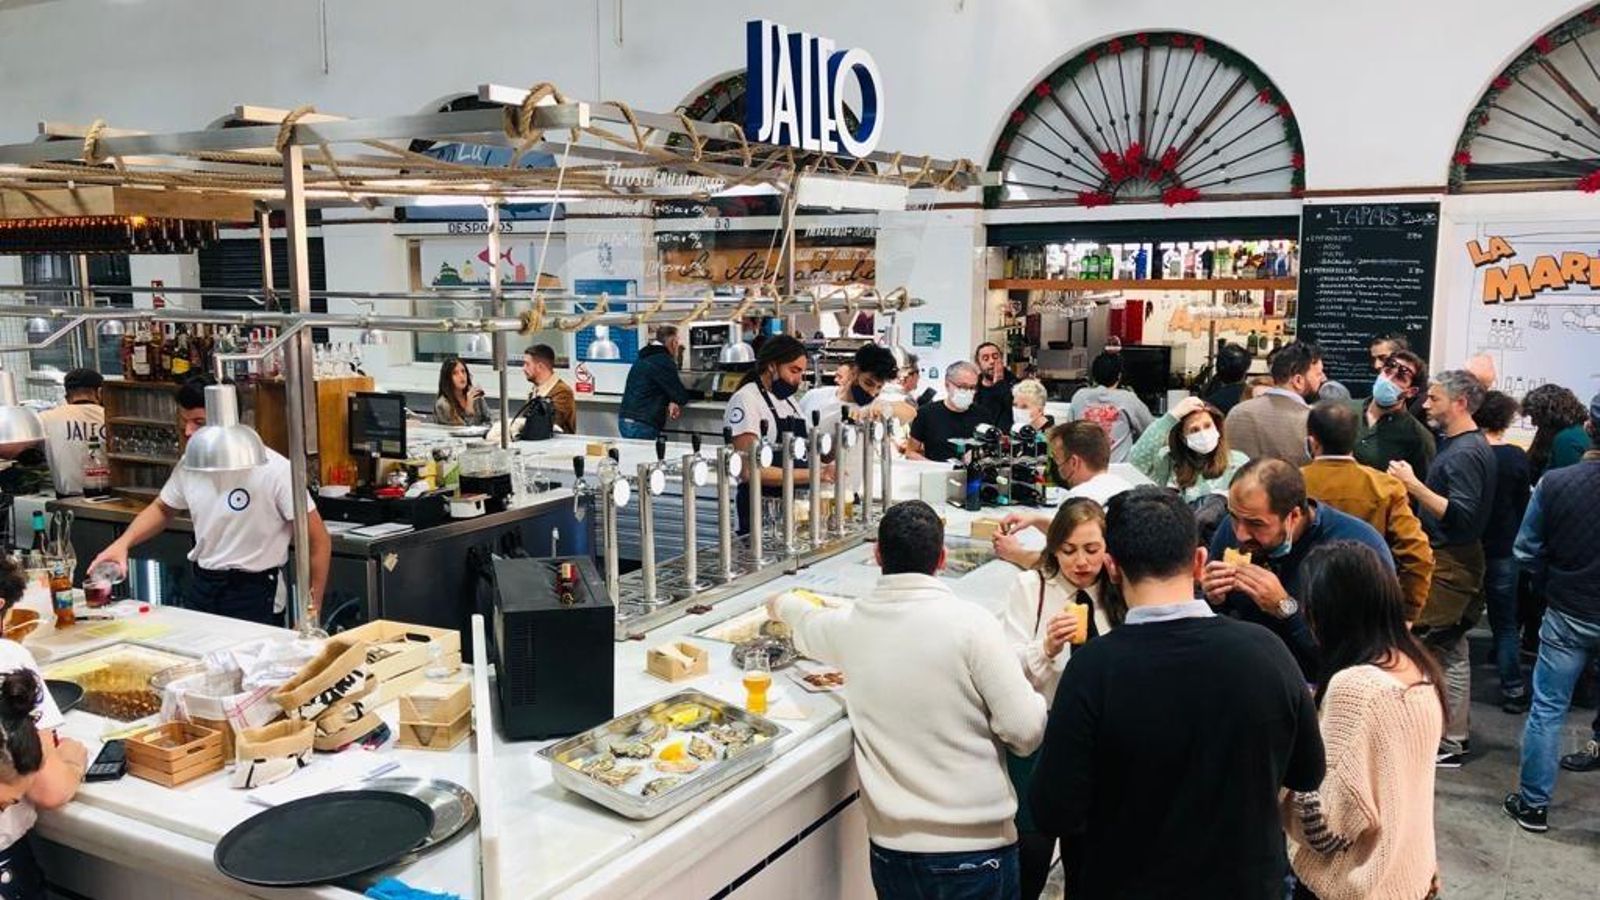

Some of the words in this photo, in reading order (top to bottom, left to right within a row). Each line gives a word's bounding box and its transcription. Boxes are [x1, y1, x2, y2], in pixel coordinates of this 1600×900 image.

[747, 19, 884, 158] JALEO
[448, 222, 512, 233] DESPOOS
[1329, 205, 1398, 225] TAPAS
[1466, 236, 1517, 267] LA
